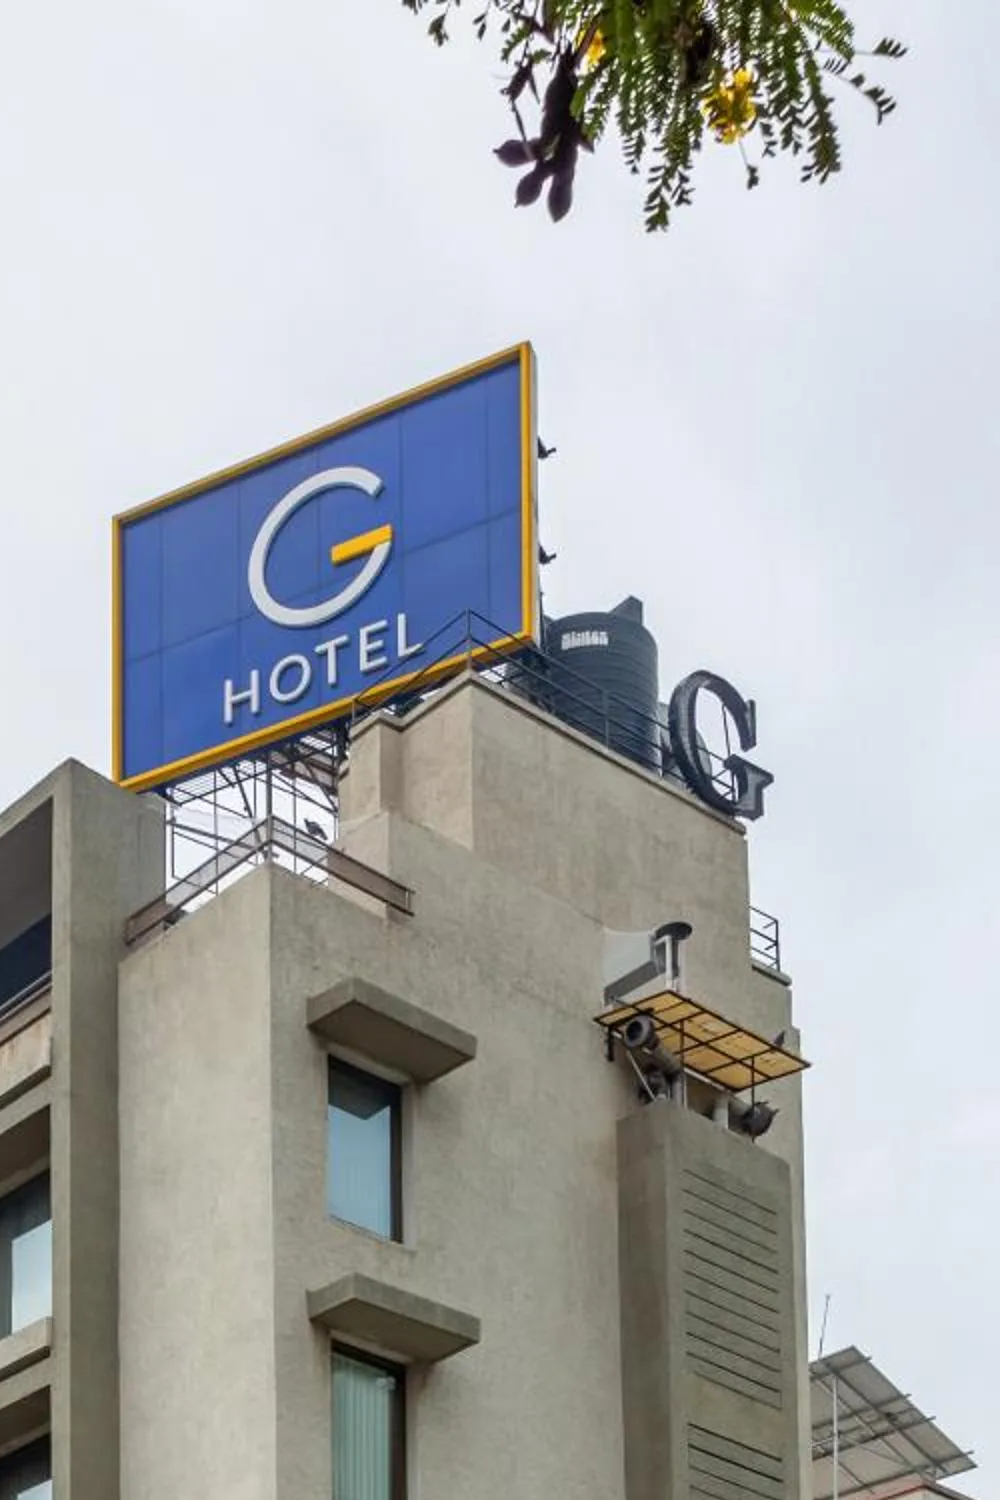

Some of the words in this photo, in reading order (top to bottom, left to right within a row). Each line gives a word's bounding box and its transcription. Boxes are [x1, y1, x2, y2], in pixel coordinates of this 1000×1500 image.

[248, 466, 393, 628] G
[223, 612, 425, 725] HOTEL
[668, 670, 774, 821] G
